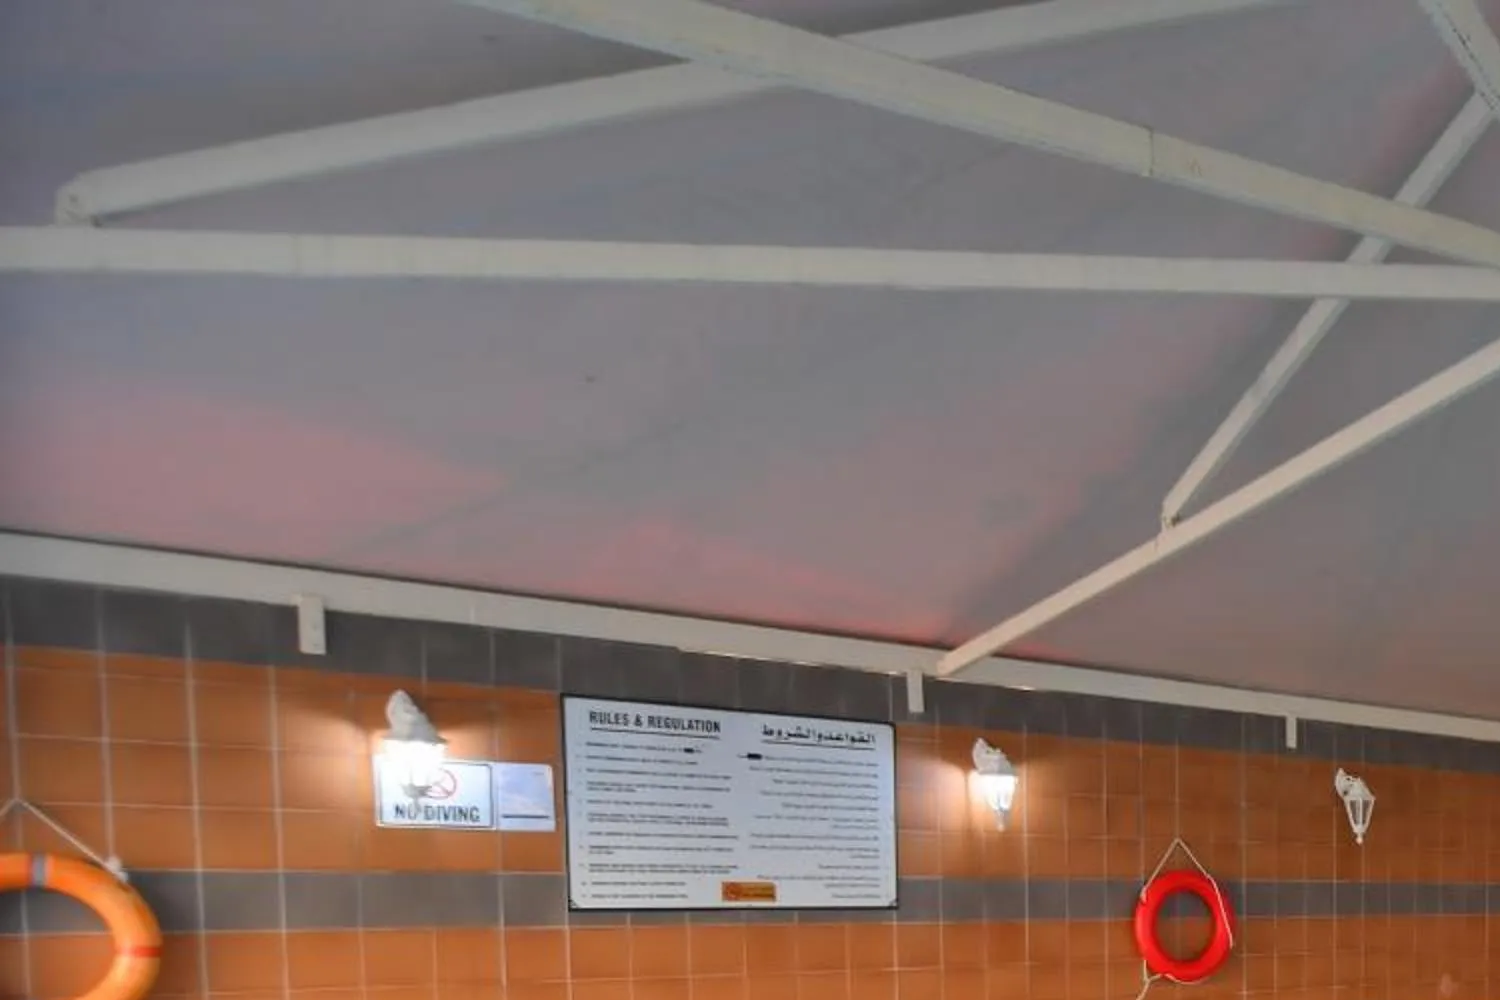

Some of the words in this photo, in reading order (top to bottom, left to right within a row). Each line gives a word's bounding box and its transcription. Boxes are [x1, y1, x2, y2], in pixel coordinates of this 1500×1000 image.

[589, 710, 629, 727] RULES
[635, 712, 643, 728] &
[647, 714, 721, 734] REGULATION
[394, 803, 419, 820] NO
[423, 805, 481, 823] DIVING
